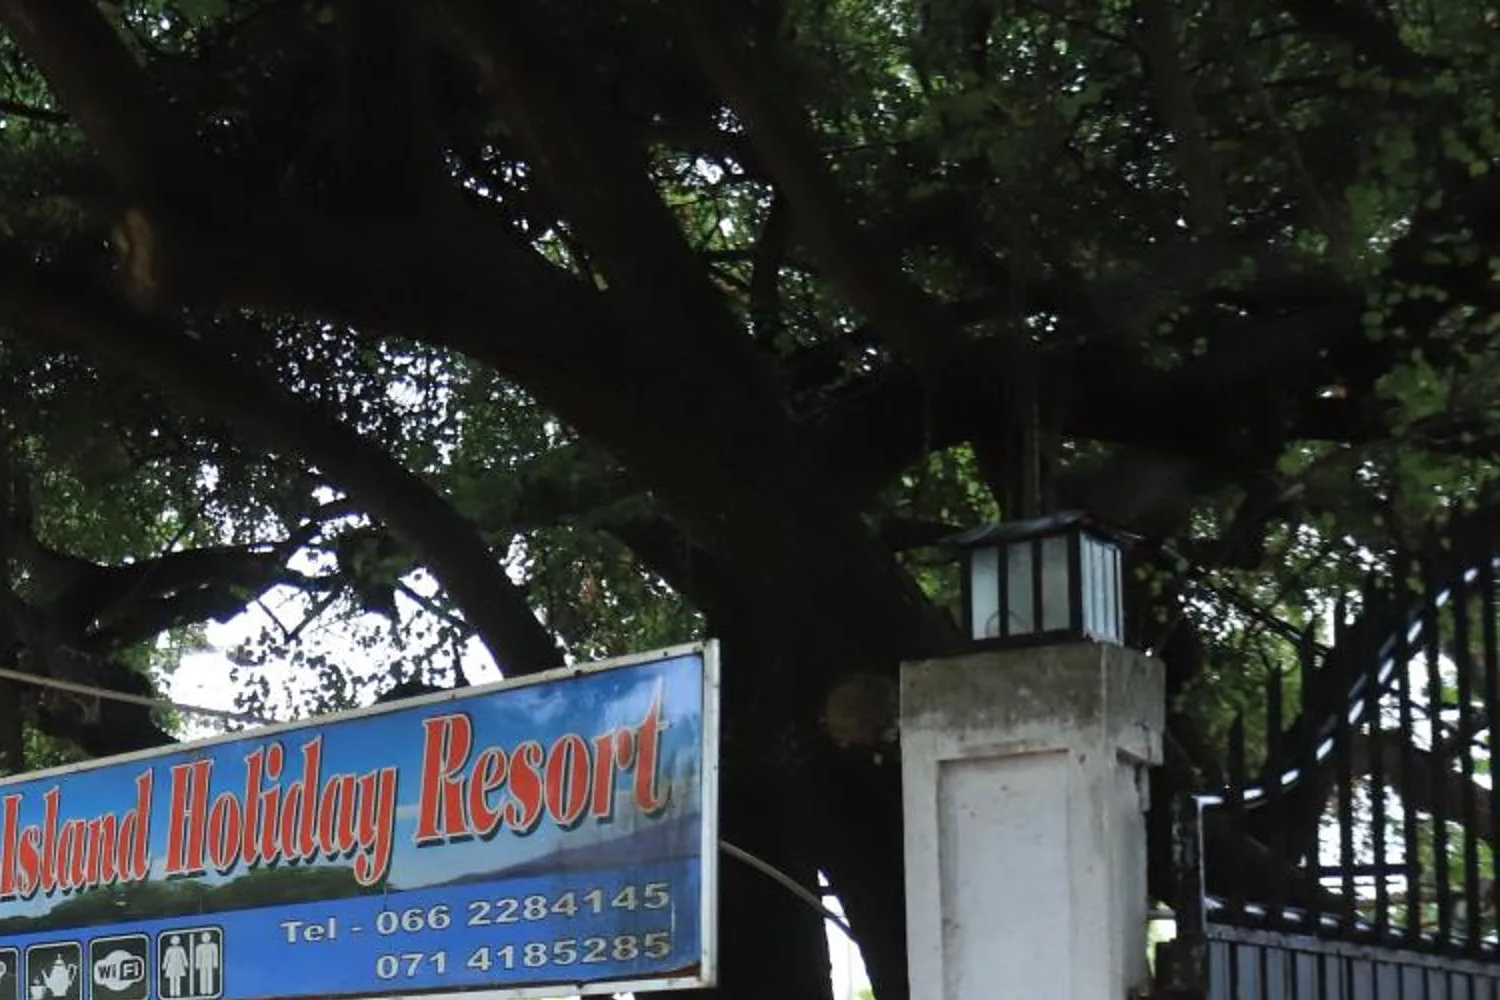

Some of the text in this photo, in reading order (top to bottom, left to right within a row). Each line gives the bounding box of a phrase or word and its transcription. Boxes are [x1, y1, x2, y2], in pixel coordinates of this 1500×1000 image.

[165, 735, 399, 886] Holiday
[416, 676, 672, 843] Resort
[281, 918, 336, 944] Tel
[375, 904, 452, 937] 066
[467, 882, 672, 928] 2284145
[376, 932, 672, 980] 071 4185285
